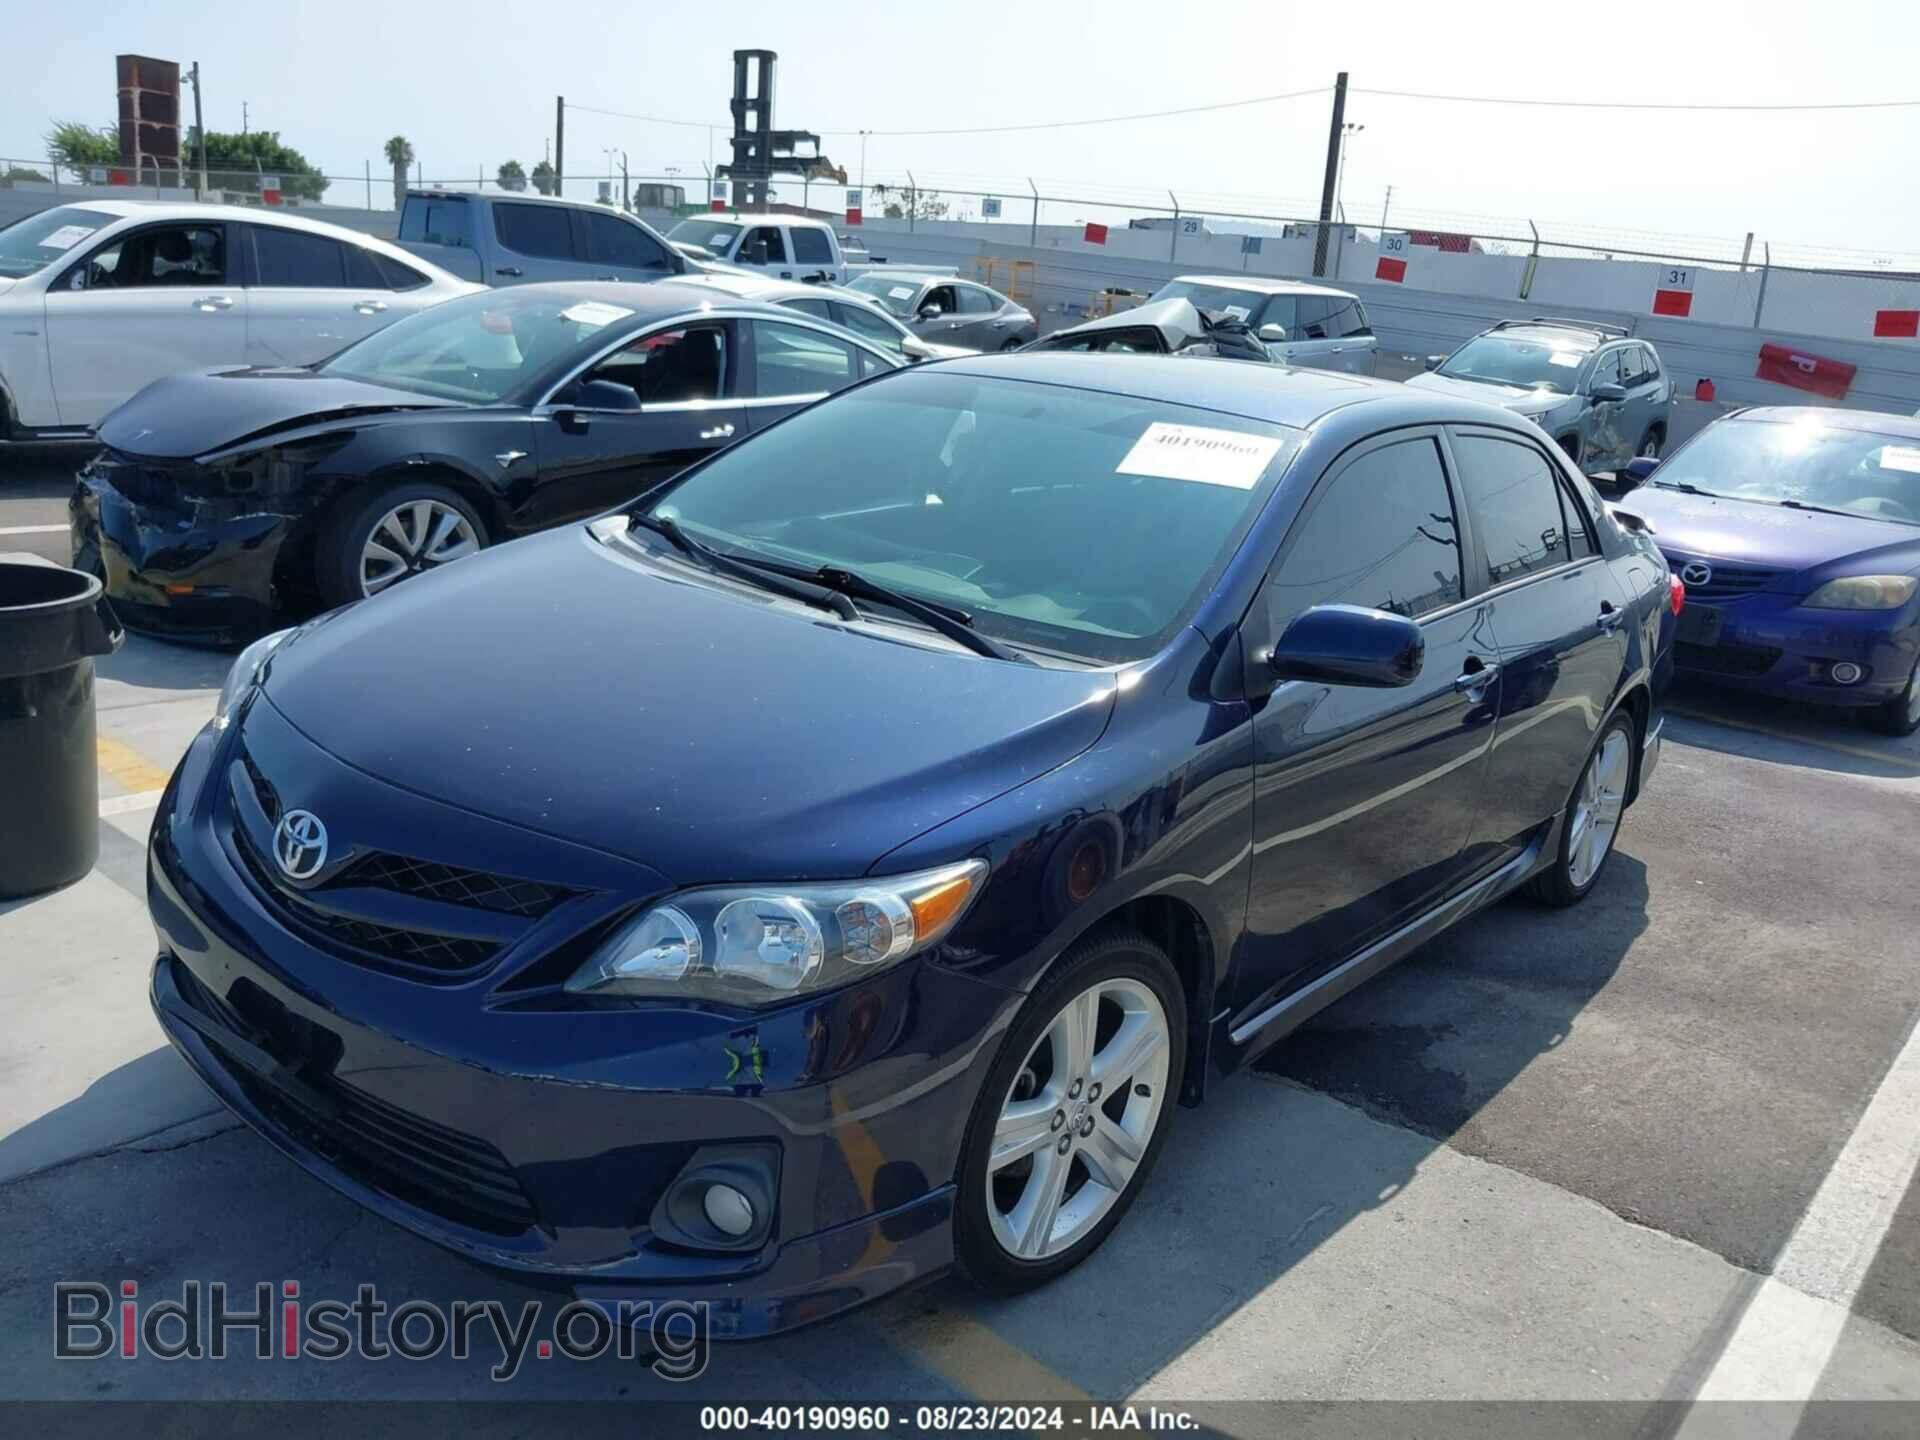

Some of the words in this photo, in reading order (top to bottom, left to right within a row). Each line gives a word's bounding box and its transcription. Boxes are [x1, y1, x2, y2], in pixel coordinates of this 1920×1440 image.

[1184, 222, 1197, 233] 29
[1386, 238, 1402, 251] 30
[1669, 270, 1687, 285] 31
